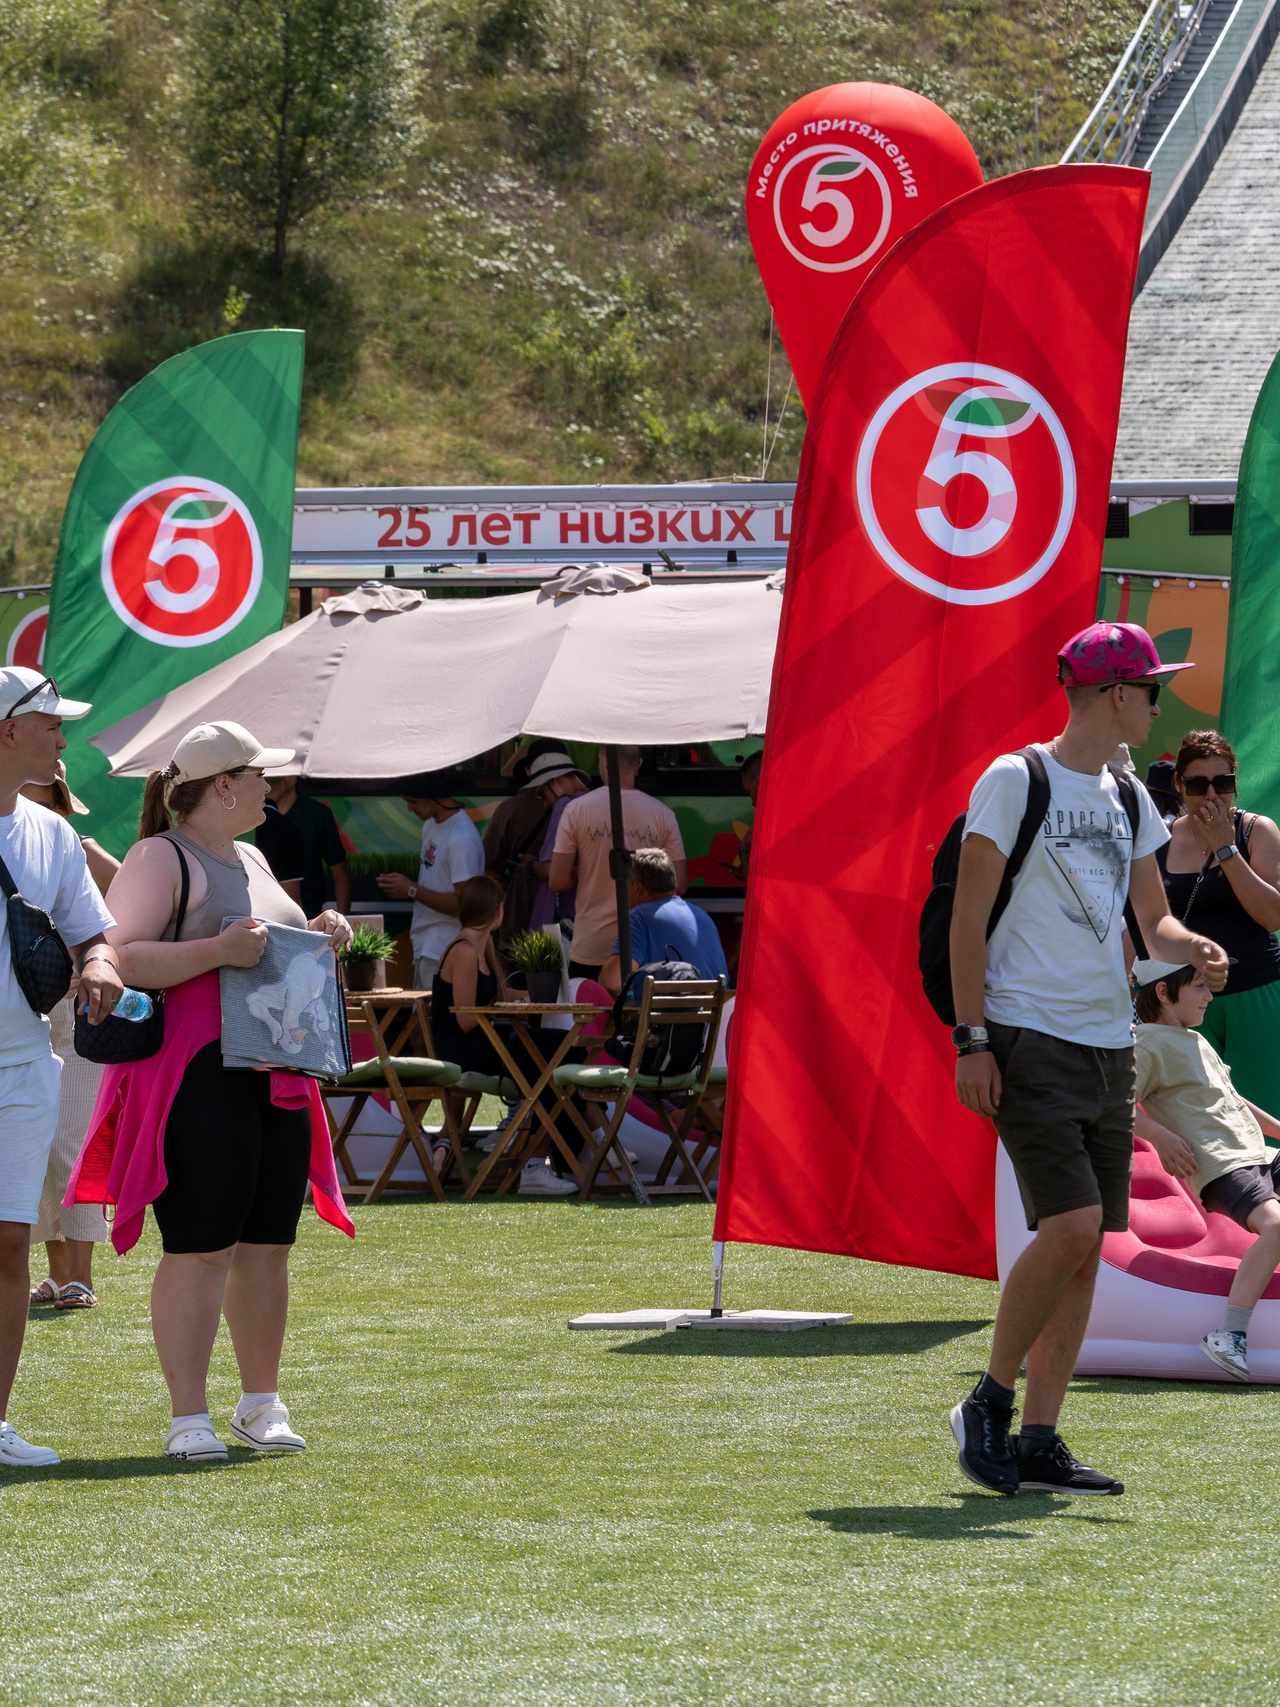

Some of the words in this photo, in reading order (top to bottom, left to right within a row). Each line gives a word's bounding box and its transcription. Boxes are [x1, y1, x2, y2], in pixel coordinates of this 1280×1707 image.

[756, 132, 798, 198] Место
[803, 119, 919, 198] притяжения
[799, 154, 867, 248] 5
[915, 385, 1039, 557] 5
[143, 491, 235, 614] 5
[377, 507, 431, 548] 25
[447, 511, 540, 547] лет
[559, 508, 756, 544] низких
